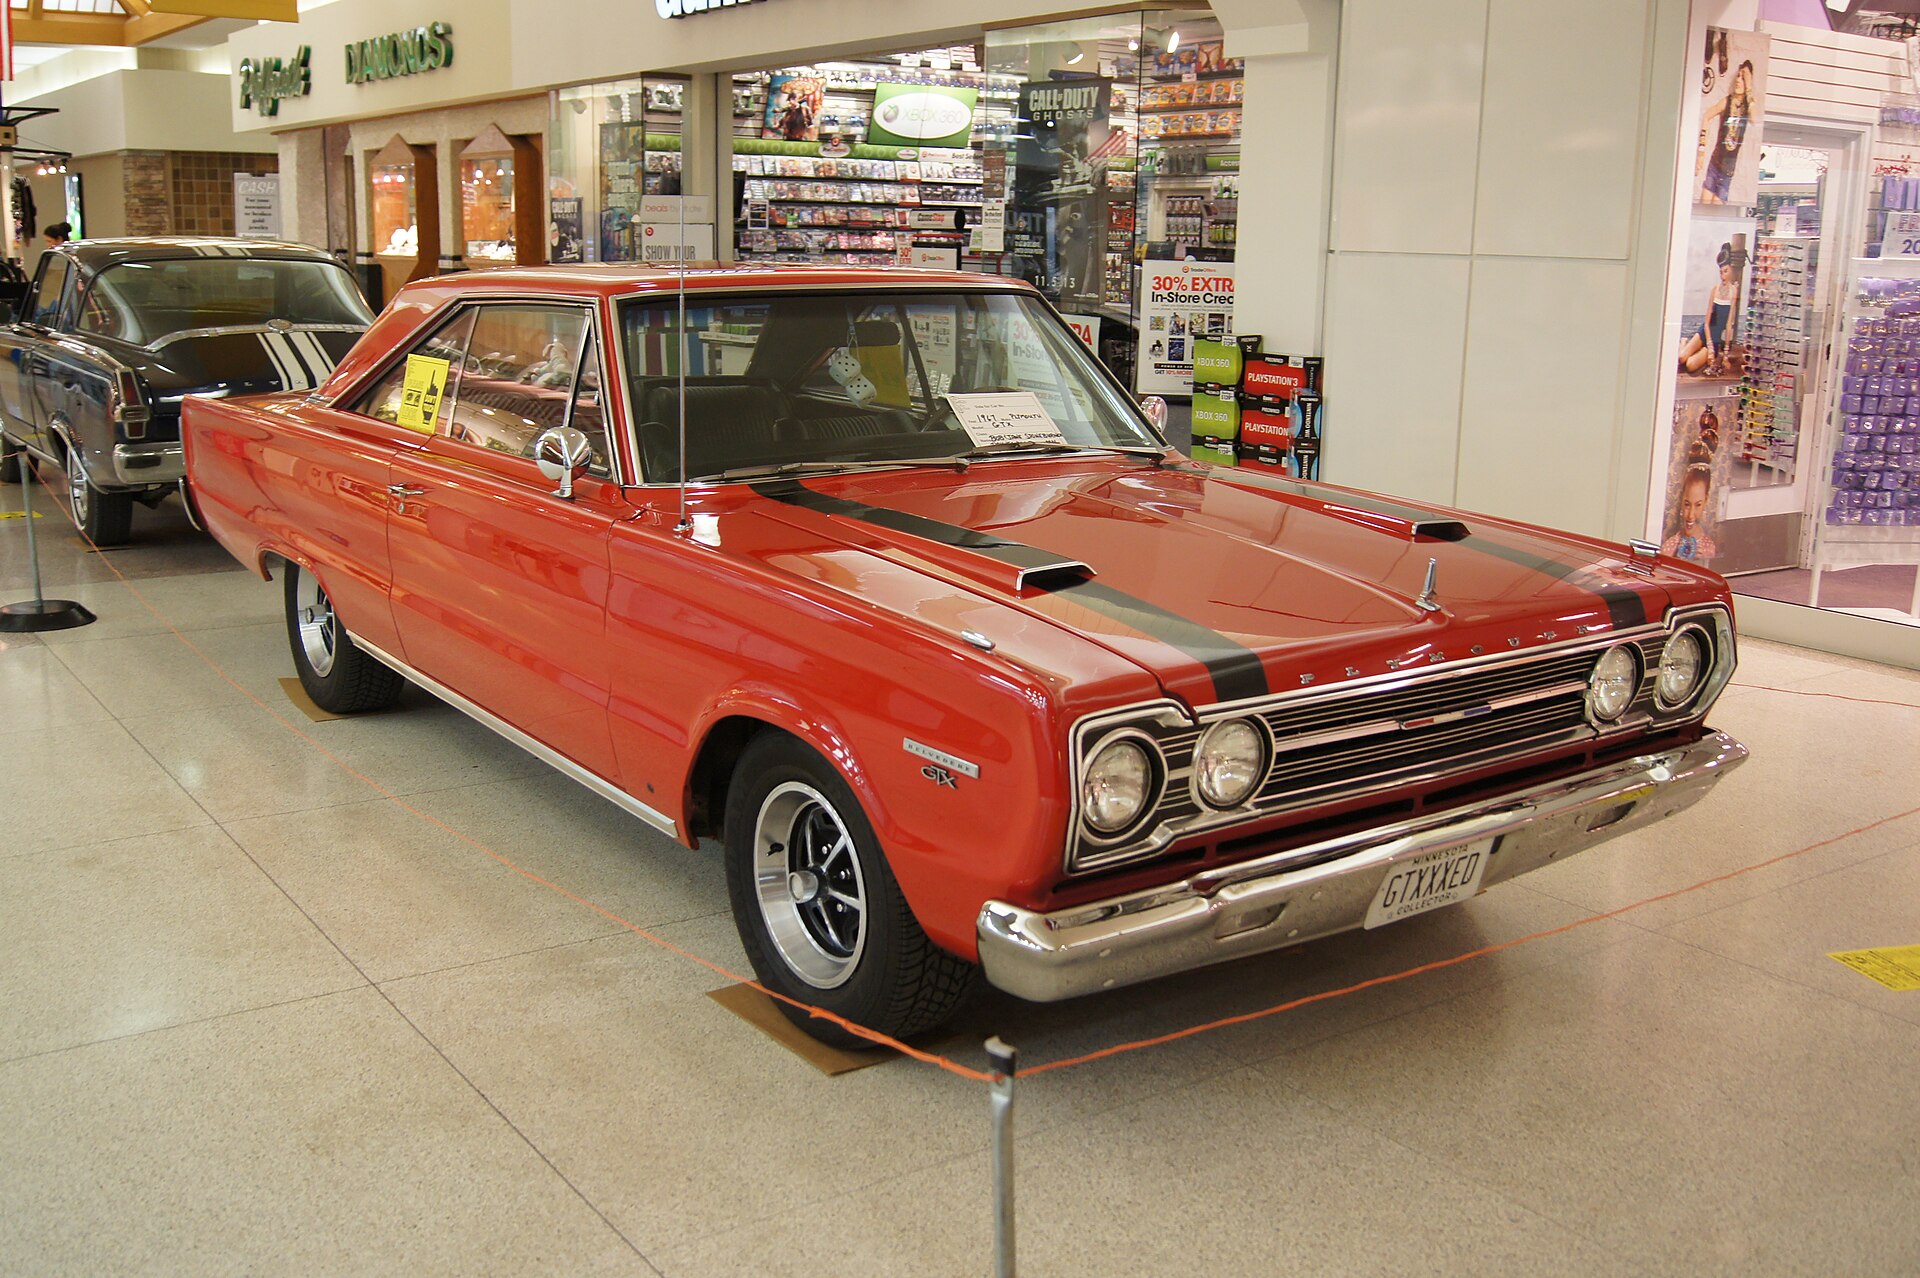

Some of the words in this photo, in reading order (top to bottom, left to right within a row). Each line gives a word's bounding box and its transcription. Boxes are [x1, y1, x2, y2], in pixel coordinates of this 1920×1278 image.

[345, 21, 453, 84] DIAMONDS
[1029, 89, 1059, 111] CALL
[1063, 87, 1099, 109] DUTY
[1033, 109, 1094, 120] GHOSTS
[238, 181, 277, 194] CASH
[645, 245, 671, 260] SHOW
[1152, 275, 1188, 292] 30%
[1191, 276, 1235, 293] EXTR
[1151, 291, 1201, 303] In-Store
[1197, 357, 1215, 366] XBOX
[1215, 358, 1230, 368] 360
[1247, 372, 1293, 386] PLAYSTATION
[976, 413, 997, 423] 1967
[1195, 410, 1214, 420] XBOX
[1214, 412, 1228, 422] 360
[1305, 402, 1313, 428] NINTENDO
[991, 421, 1014, 429] GTX
[1299, 624, 1590, 685] PLYMOUTH
[907, 743, 970, 772] BELVEDERE
[921, 765, 957, 790] GTX
[1412, 844, 1469, 866] MINNESOTA
[1382, 852, 1480, 908] GTXXXED
[1396, 893, 1452, 915] COLLECTOR
